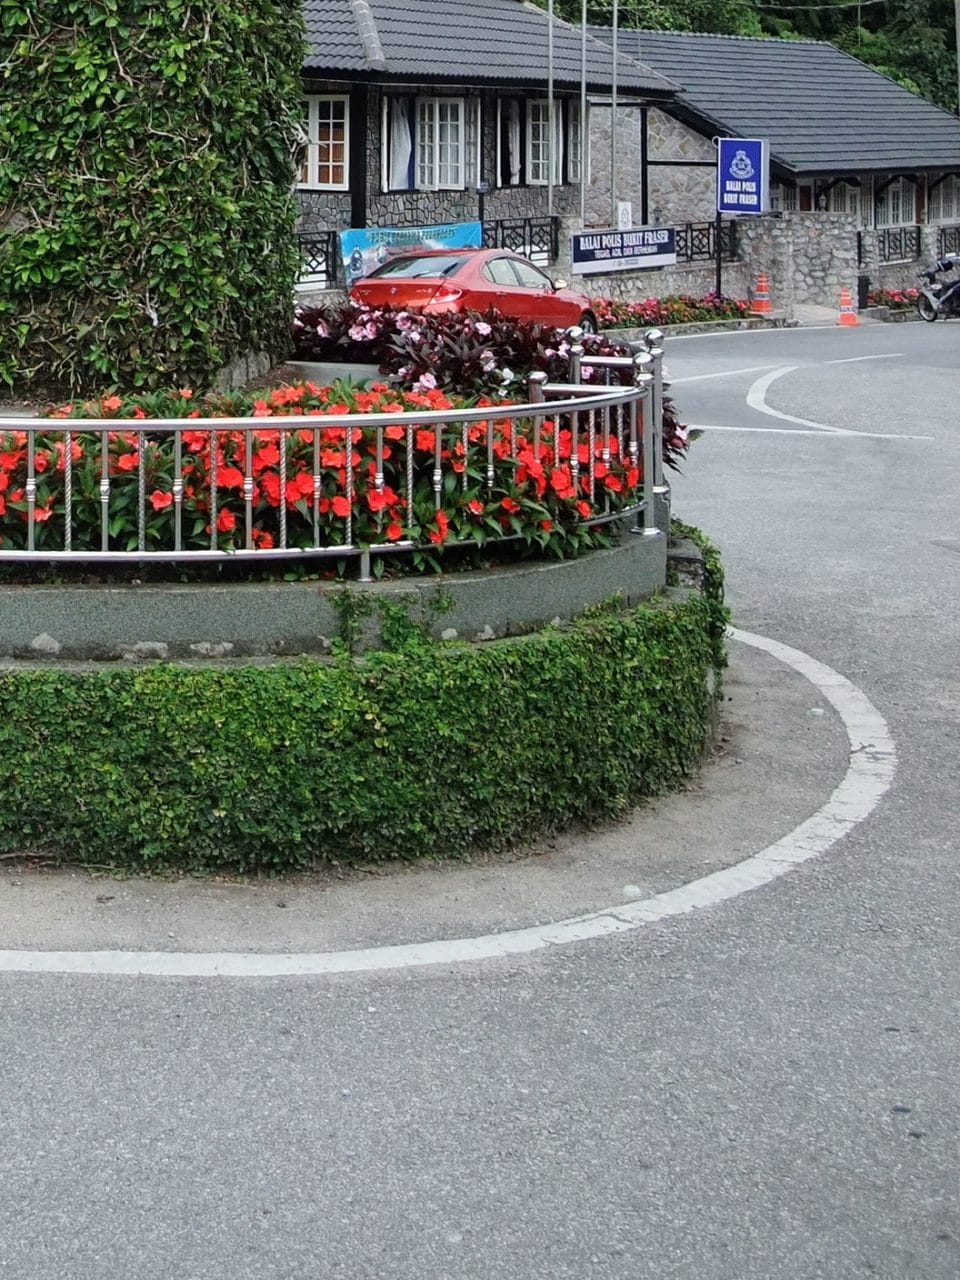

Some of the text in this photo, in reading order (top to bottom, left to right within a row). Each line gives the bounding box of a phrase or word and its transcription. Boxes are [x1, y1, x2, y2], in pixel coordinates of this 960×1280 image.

[580, 230, 669, 250] BALAI POLIS BUKIT FRASER
